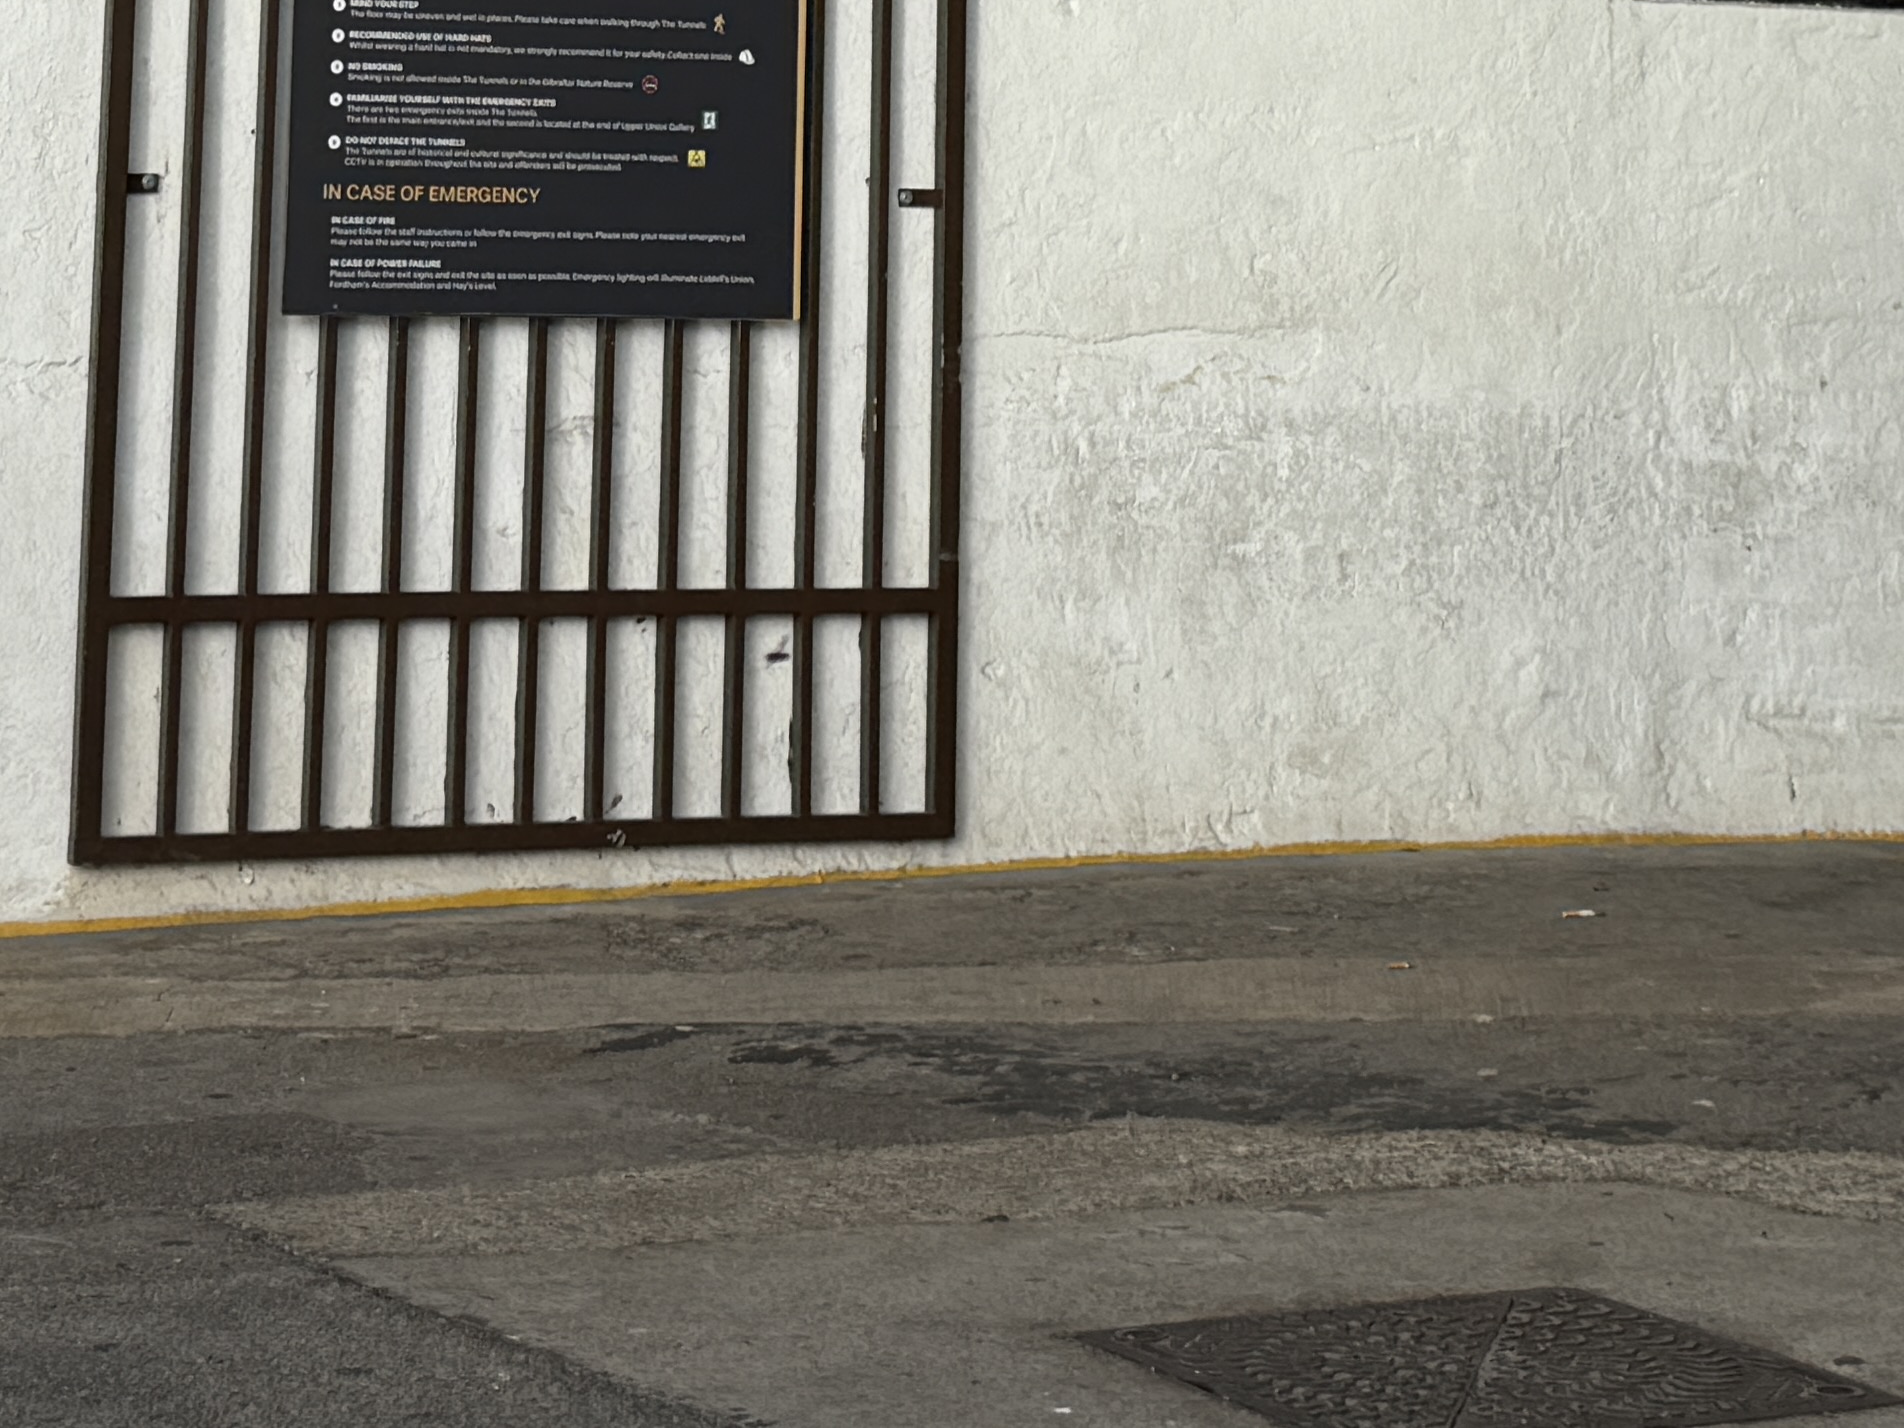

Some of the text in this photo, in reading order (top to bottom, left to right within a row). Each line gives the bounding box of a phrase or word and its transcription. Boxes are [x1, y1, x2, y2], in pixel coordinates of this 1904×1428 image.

[323, 183, 541, 204] IN CASE OF EMERGENCY
[342, 215, 364, 224] CASE
[377, 216, 395, 225] FIRE
